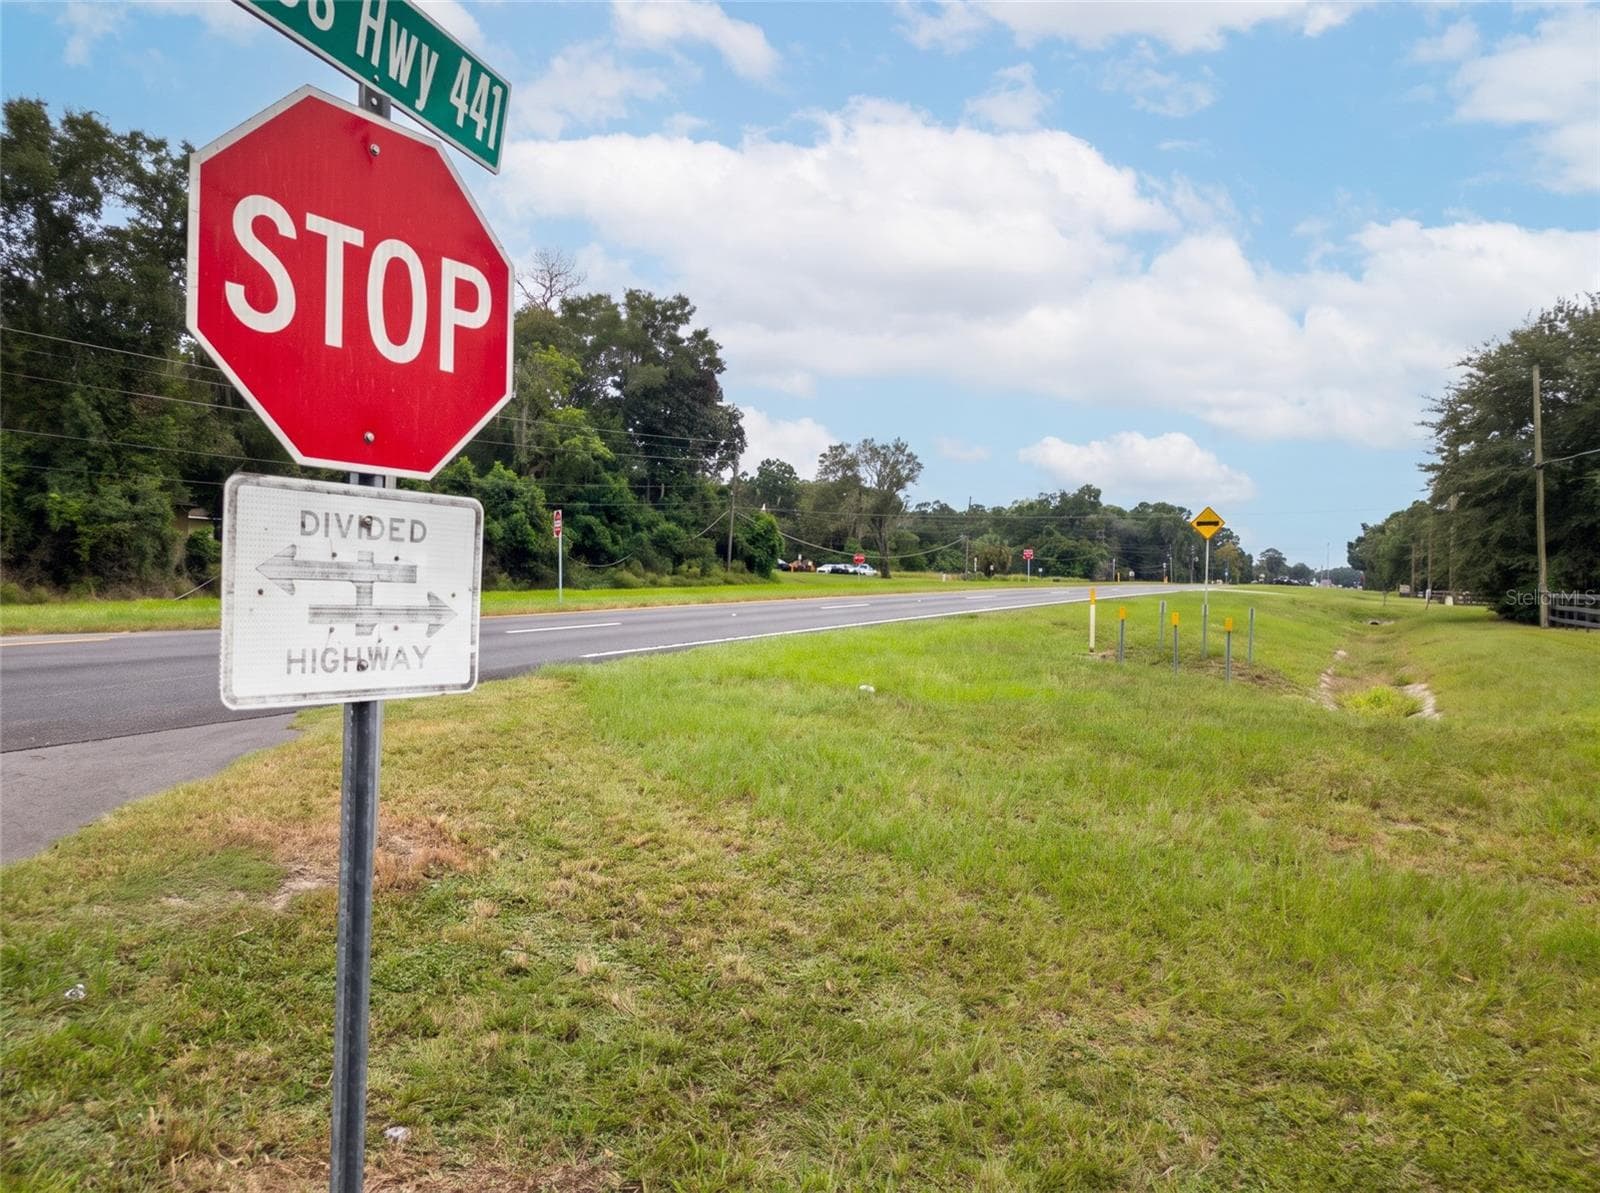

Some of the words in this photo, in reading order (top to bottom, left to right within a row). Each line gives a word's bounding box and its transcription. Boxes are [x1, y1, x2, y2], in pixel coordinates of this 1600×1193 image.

[356, 0, 438, 111] Hwy
[450, 56, 502, 150] 441
[225, 195, 492, 373] STOP
[300, 510, 427, 543] DIVIDED
[286, 645, 431, 675] HIGHWAY
